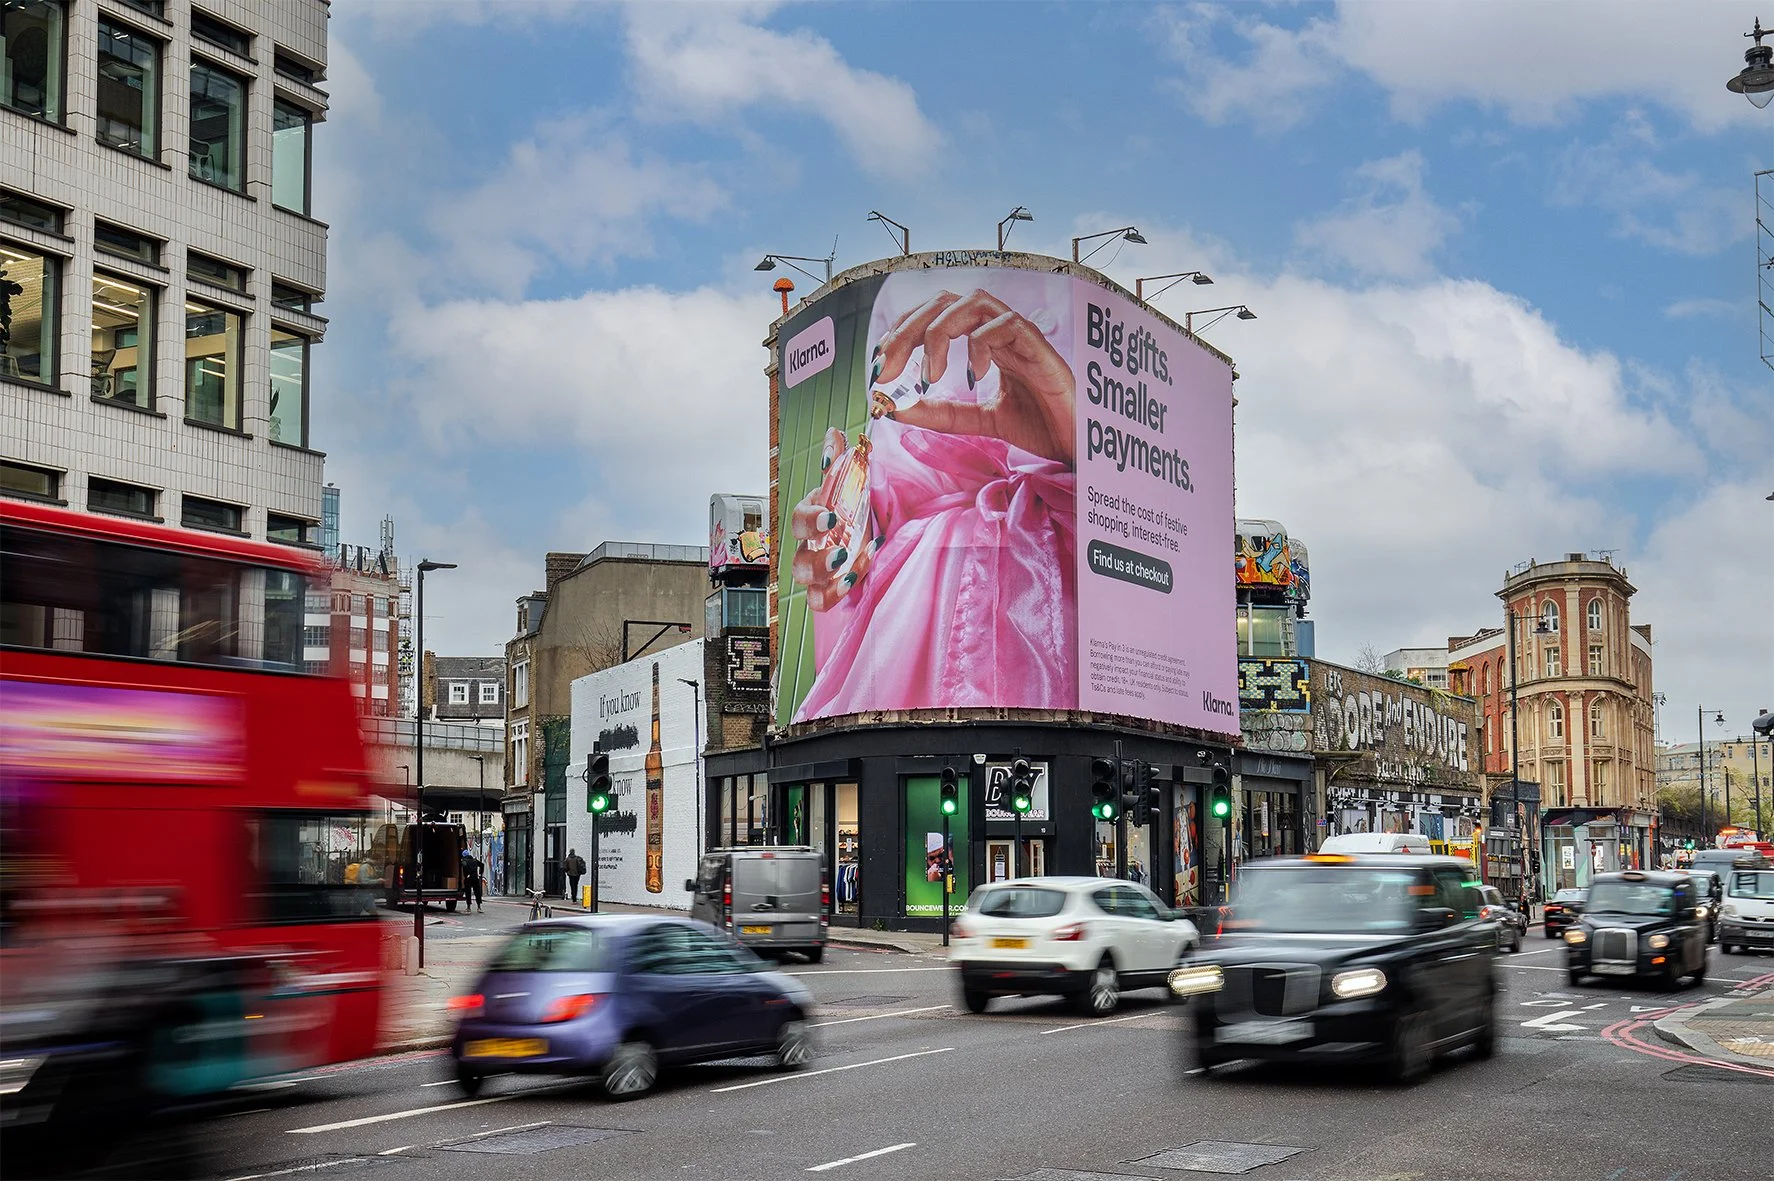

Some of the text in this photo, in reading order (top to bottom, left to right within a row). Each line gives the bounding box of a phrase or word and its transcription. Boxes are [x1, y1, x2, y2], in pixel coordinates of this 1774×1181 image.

[790, 339, 829, 374] Klarna.
[1087, 302, 1173, 386] Big gifts.
[1087, 360, 1168, 434] Smaller
[1087, 417, 1194, 493] payments.
[1087, 485, 1188, 536] Spread the cost of festive
[1087, 508, 1180, 553] shopping, interest-free.
[1093, 549, 1170, 586] Find us at checkout
[600, 689, 641, 722] If you know
[1202, 690, 1235, 717] Klarna.
[1314, 689, 1385, 752] ADORE
[1402, 697, 1468, 773] ENDURE
[906, 904, 969, 912] BOUNCEWER.CO
